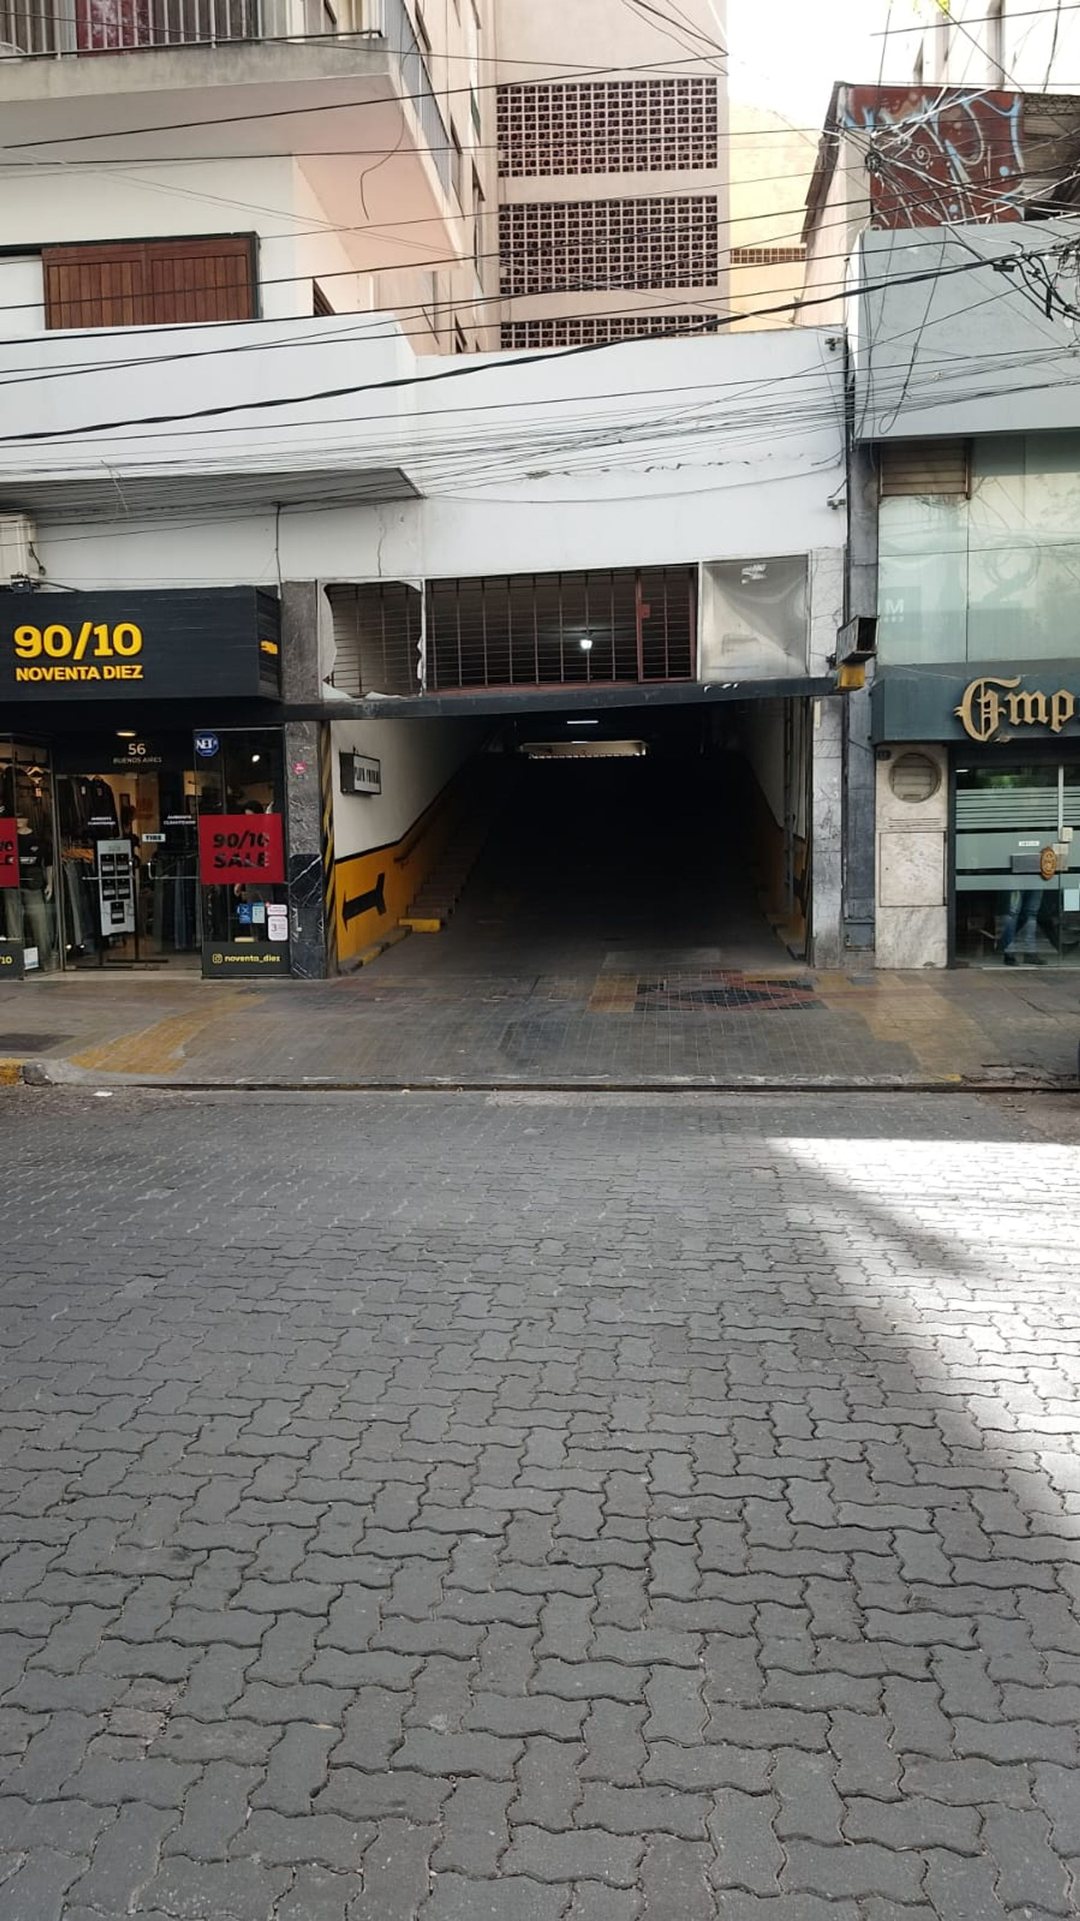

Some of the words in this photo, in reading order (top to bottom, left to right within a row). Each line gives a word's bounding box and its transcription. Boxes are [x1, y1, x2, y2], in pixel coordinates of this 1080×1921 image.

[14, 621, 143, 660] 90/10
[16, 665, 100, 681] NOVENTA
[103, 664, 144, 680] DIEZ
[128, 743, 146, 755] 56
[113, 756, 141, 764] BUENOS
[213, 852, 269, 868] SALE
[225, 954, 281, 963] noventa_diez
